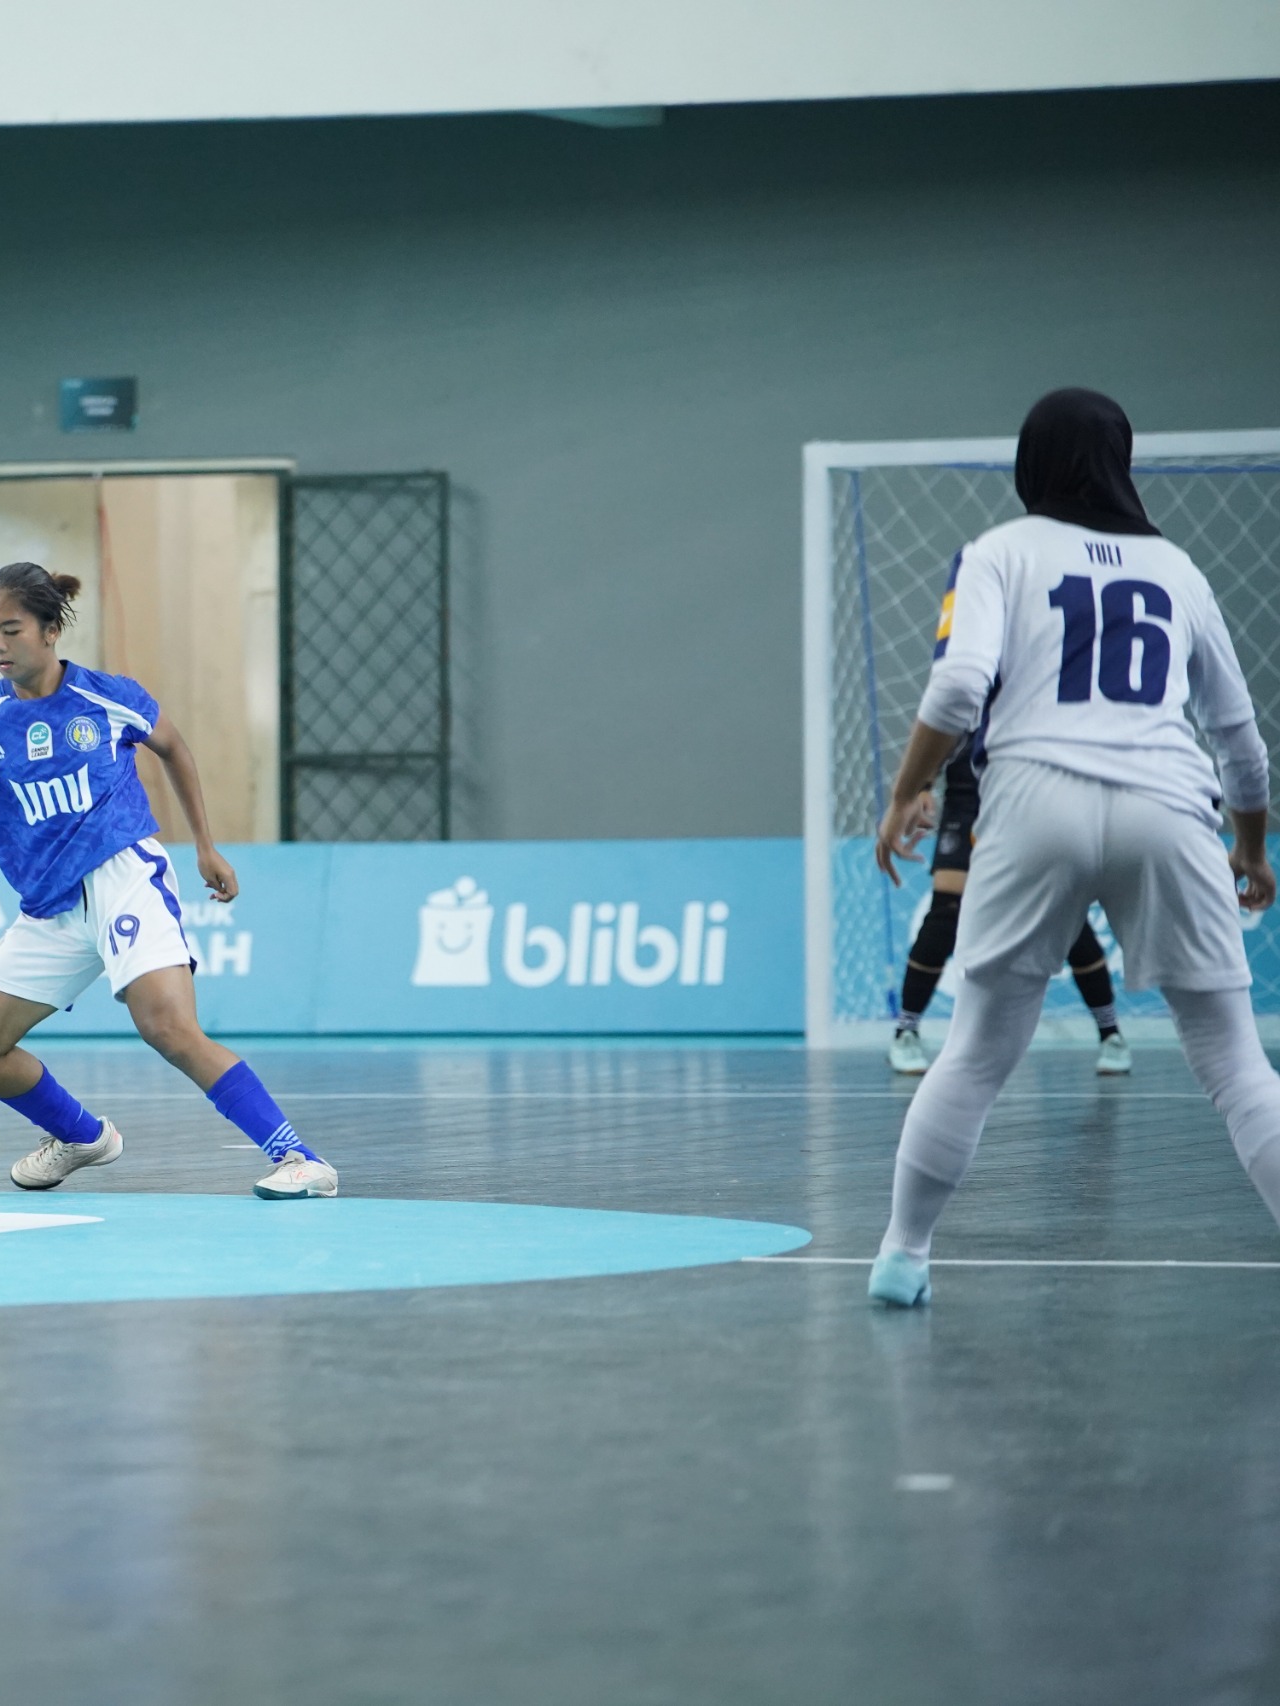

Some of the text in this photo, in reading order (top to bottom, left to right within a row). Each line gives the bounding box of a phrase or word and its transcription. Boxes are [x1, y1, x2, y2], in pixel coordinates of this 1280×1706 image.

[1085, 541, 1123, 567] YULI
[1048, 574, 1173, 706] 16
[109, 914, 140, 955] 19
[502, 900, 729, 988] blibli
